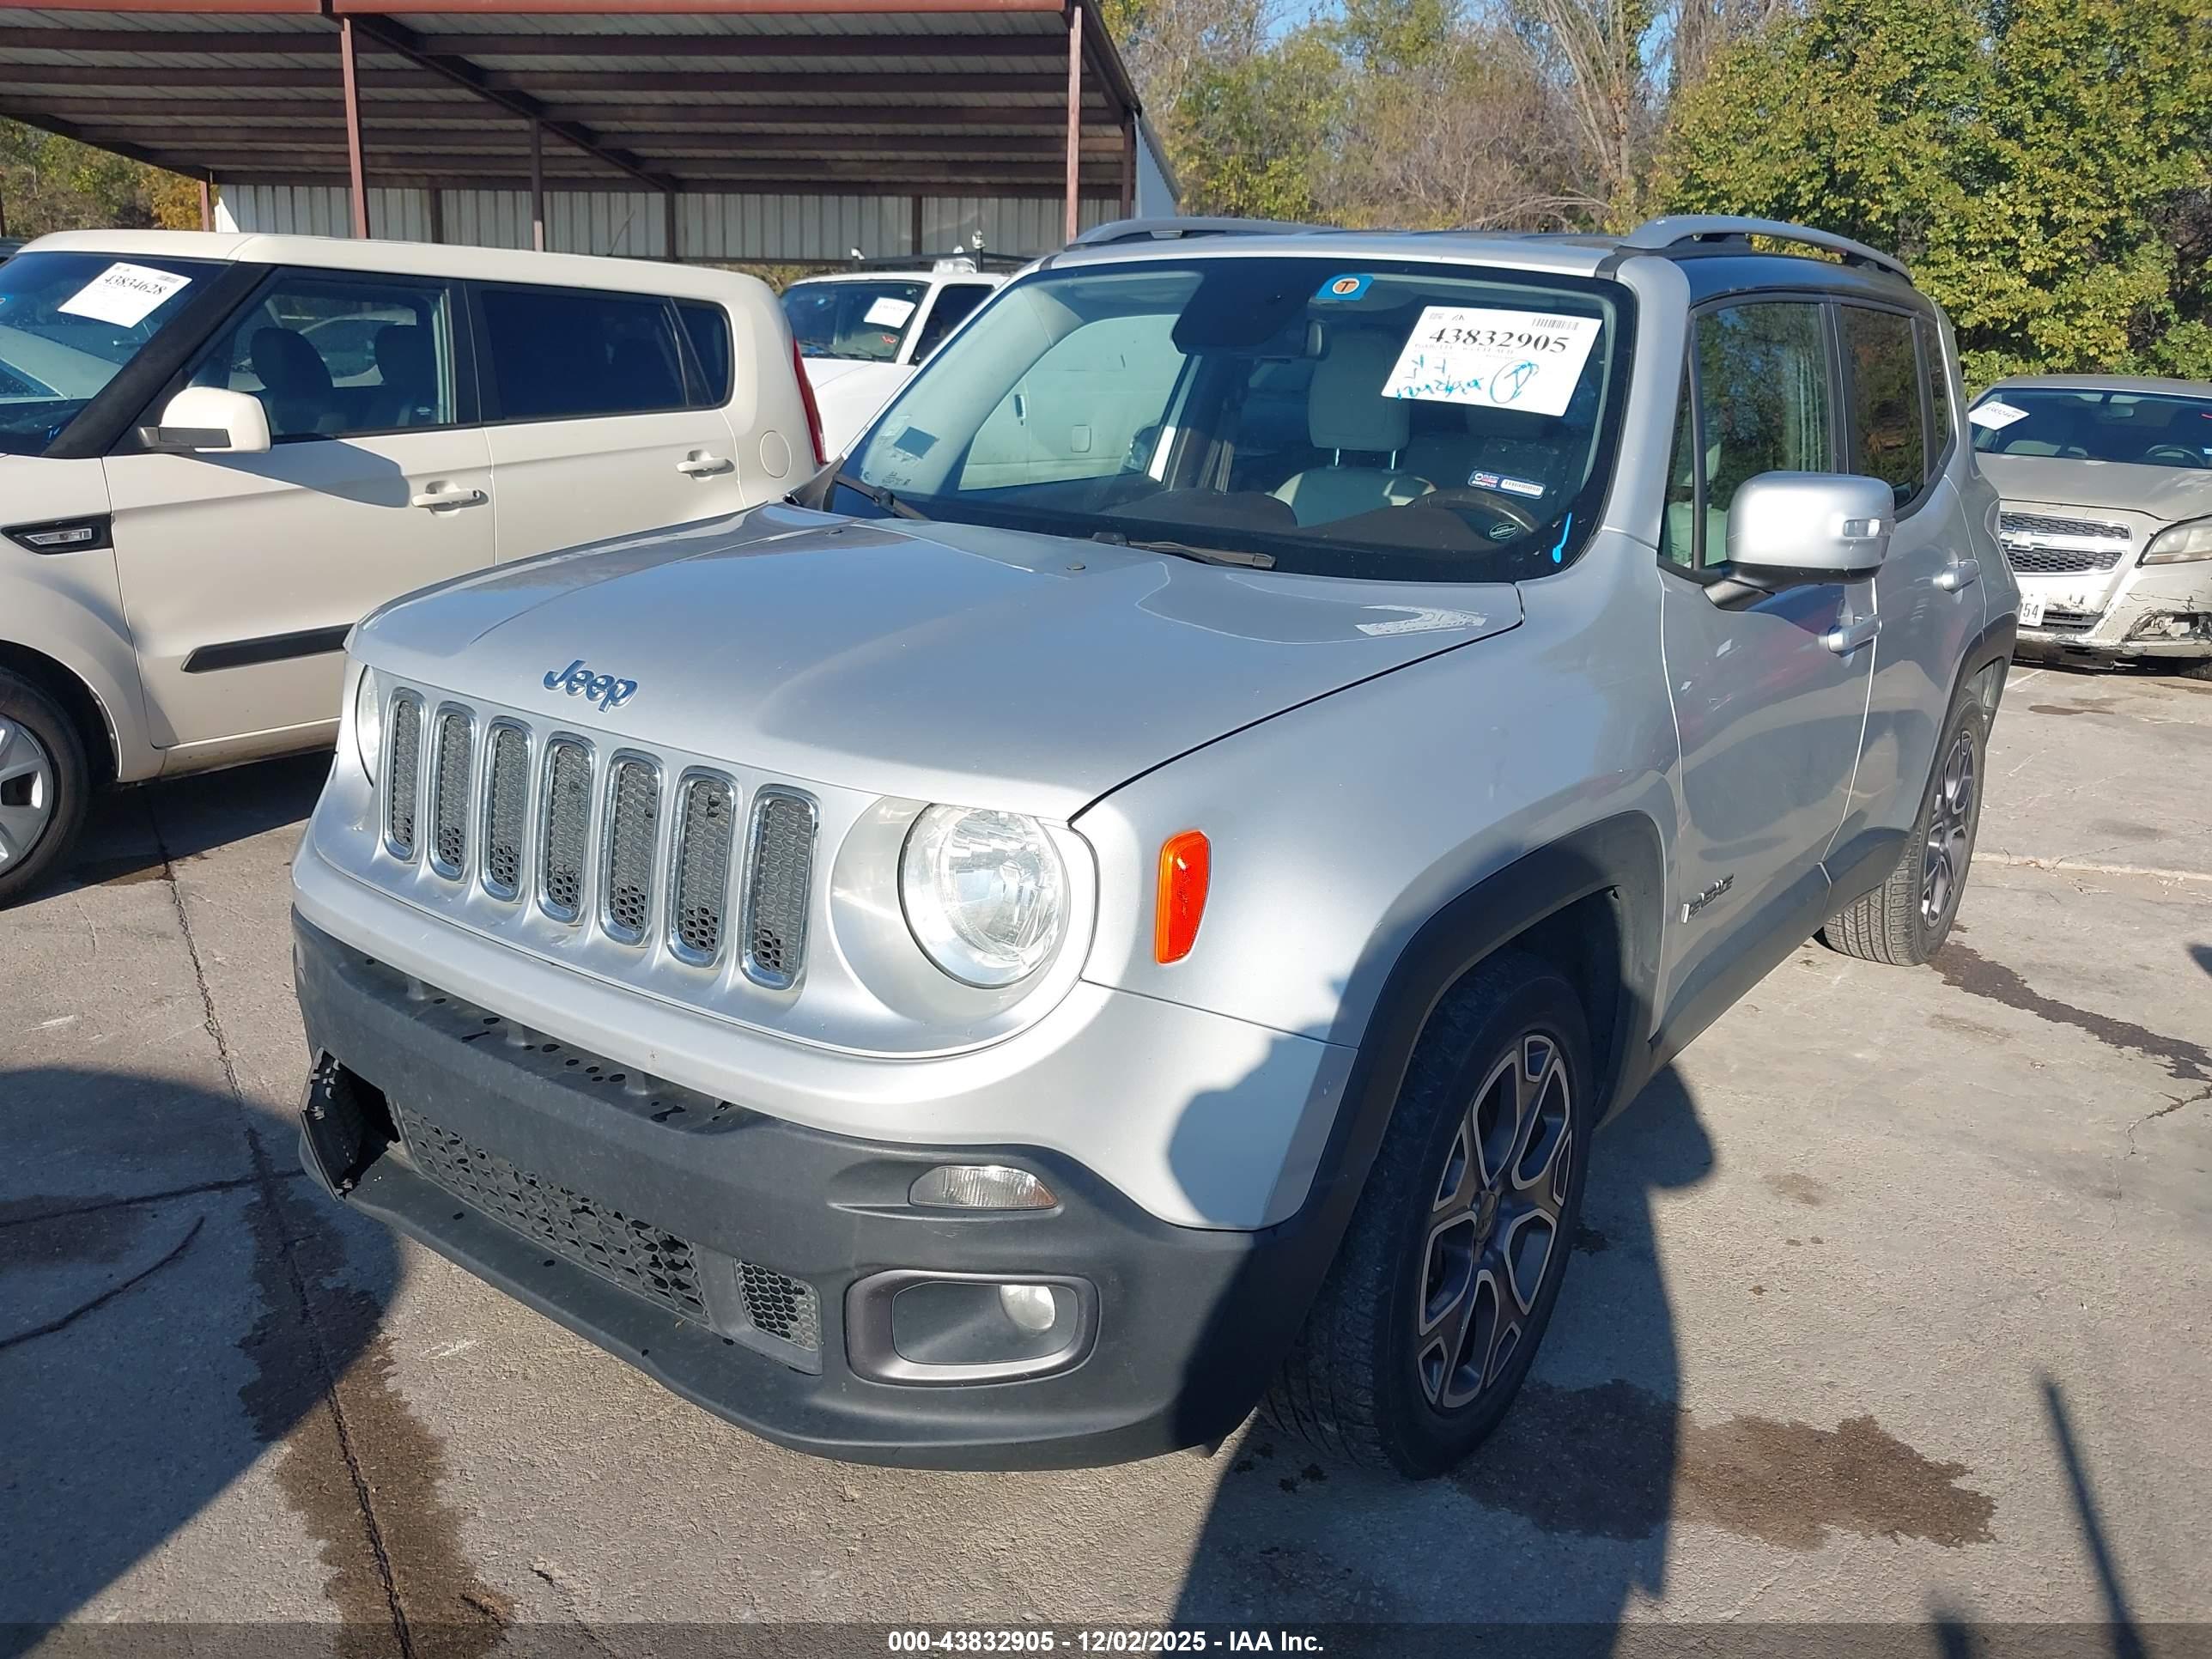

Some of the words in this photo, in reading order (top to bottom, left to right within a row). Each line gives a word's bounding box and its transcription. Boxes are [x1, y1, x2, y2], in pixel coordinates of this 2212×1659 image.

[105, 274, 167, 295] 43834628
[1429, 327, 1571, 353] 43832905
[544, 659, 638, 714] Jeep
